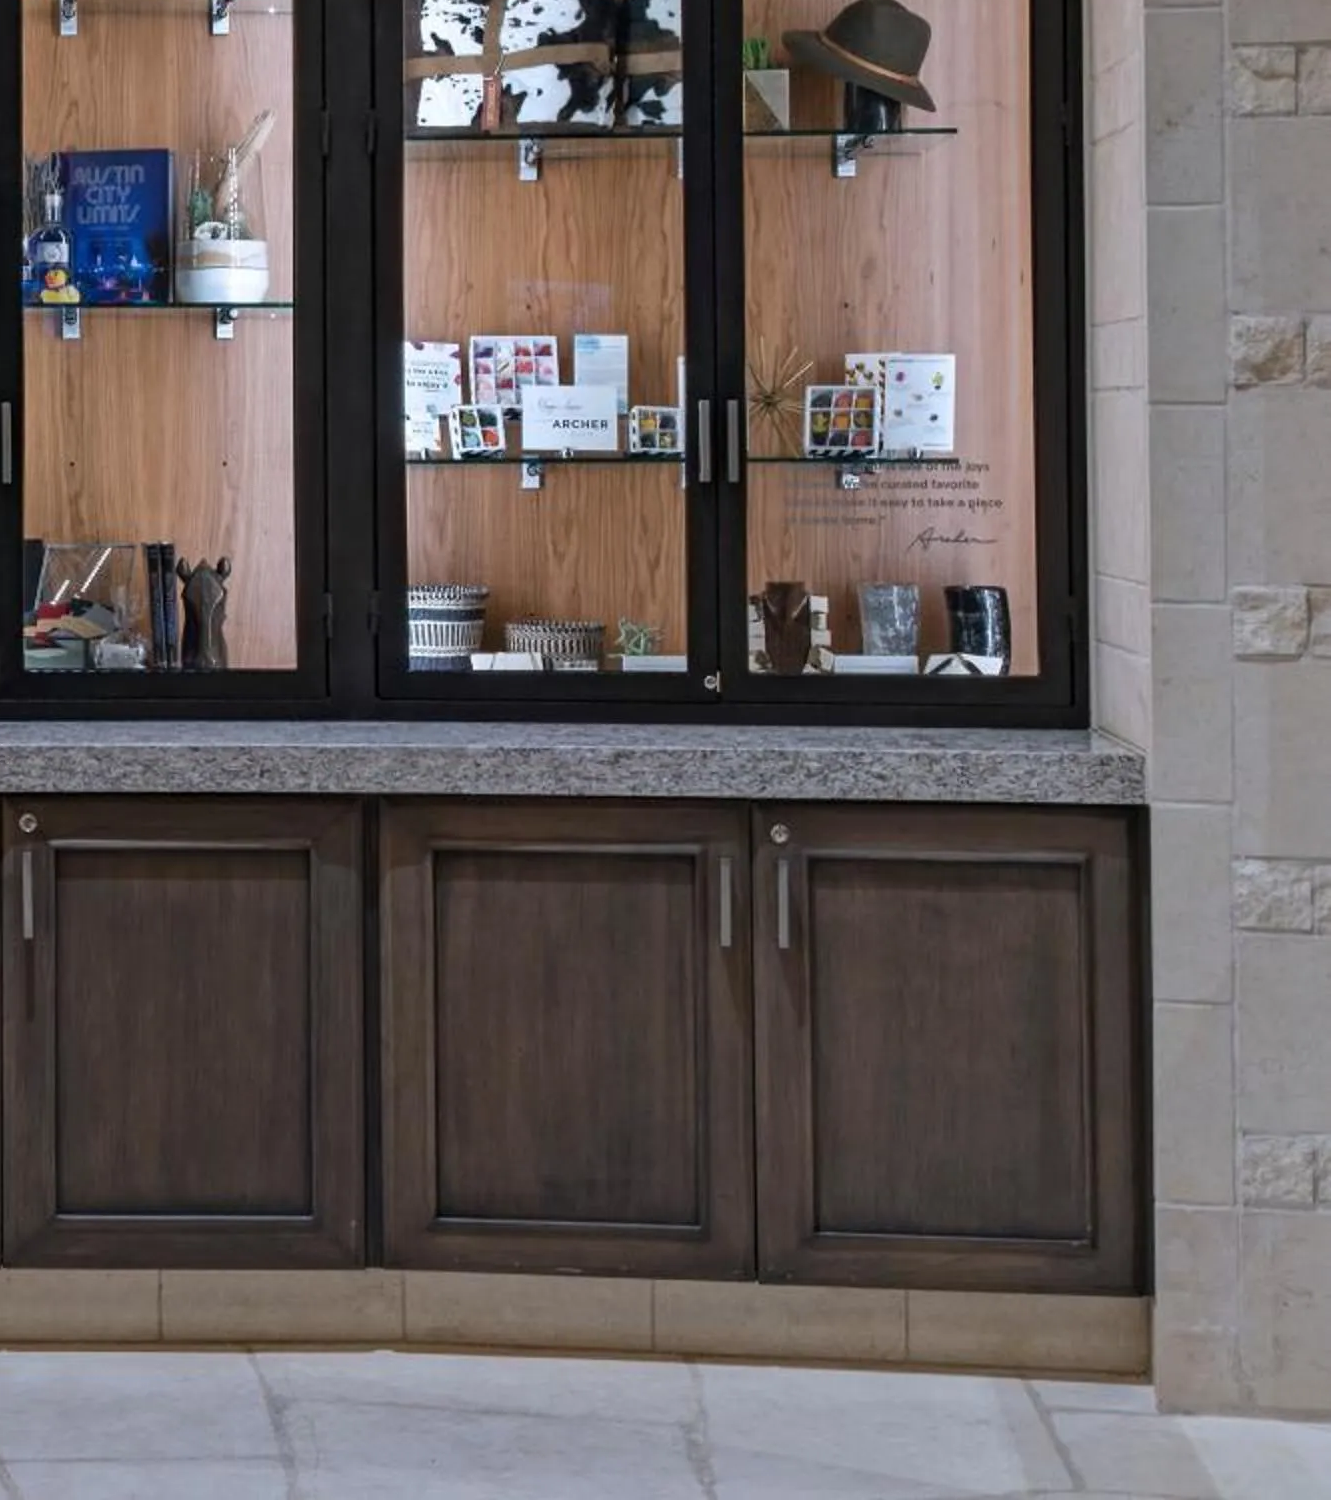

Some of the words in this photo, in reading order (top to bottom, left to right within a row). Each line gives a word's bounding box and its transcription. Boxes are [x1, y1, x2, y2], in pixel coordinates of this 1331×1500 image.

[71, 164, 145, 185] AUSTIN
[86, 185, 131, 203] CITY
[552, 419, 608, 430] ARCHER
[931, 480, 980, 490] favorite
[928, 498, 955, 508] take
[968, 498, 1003, 511] piece
